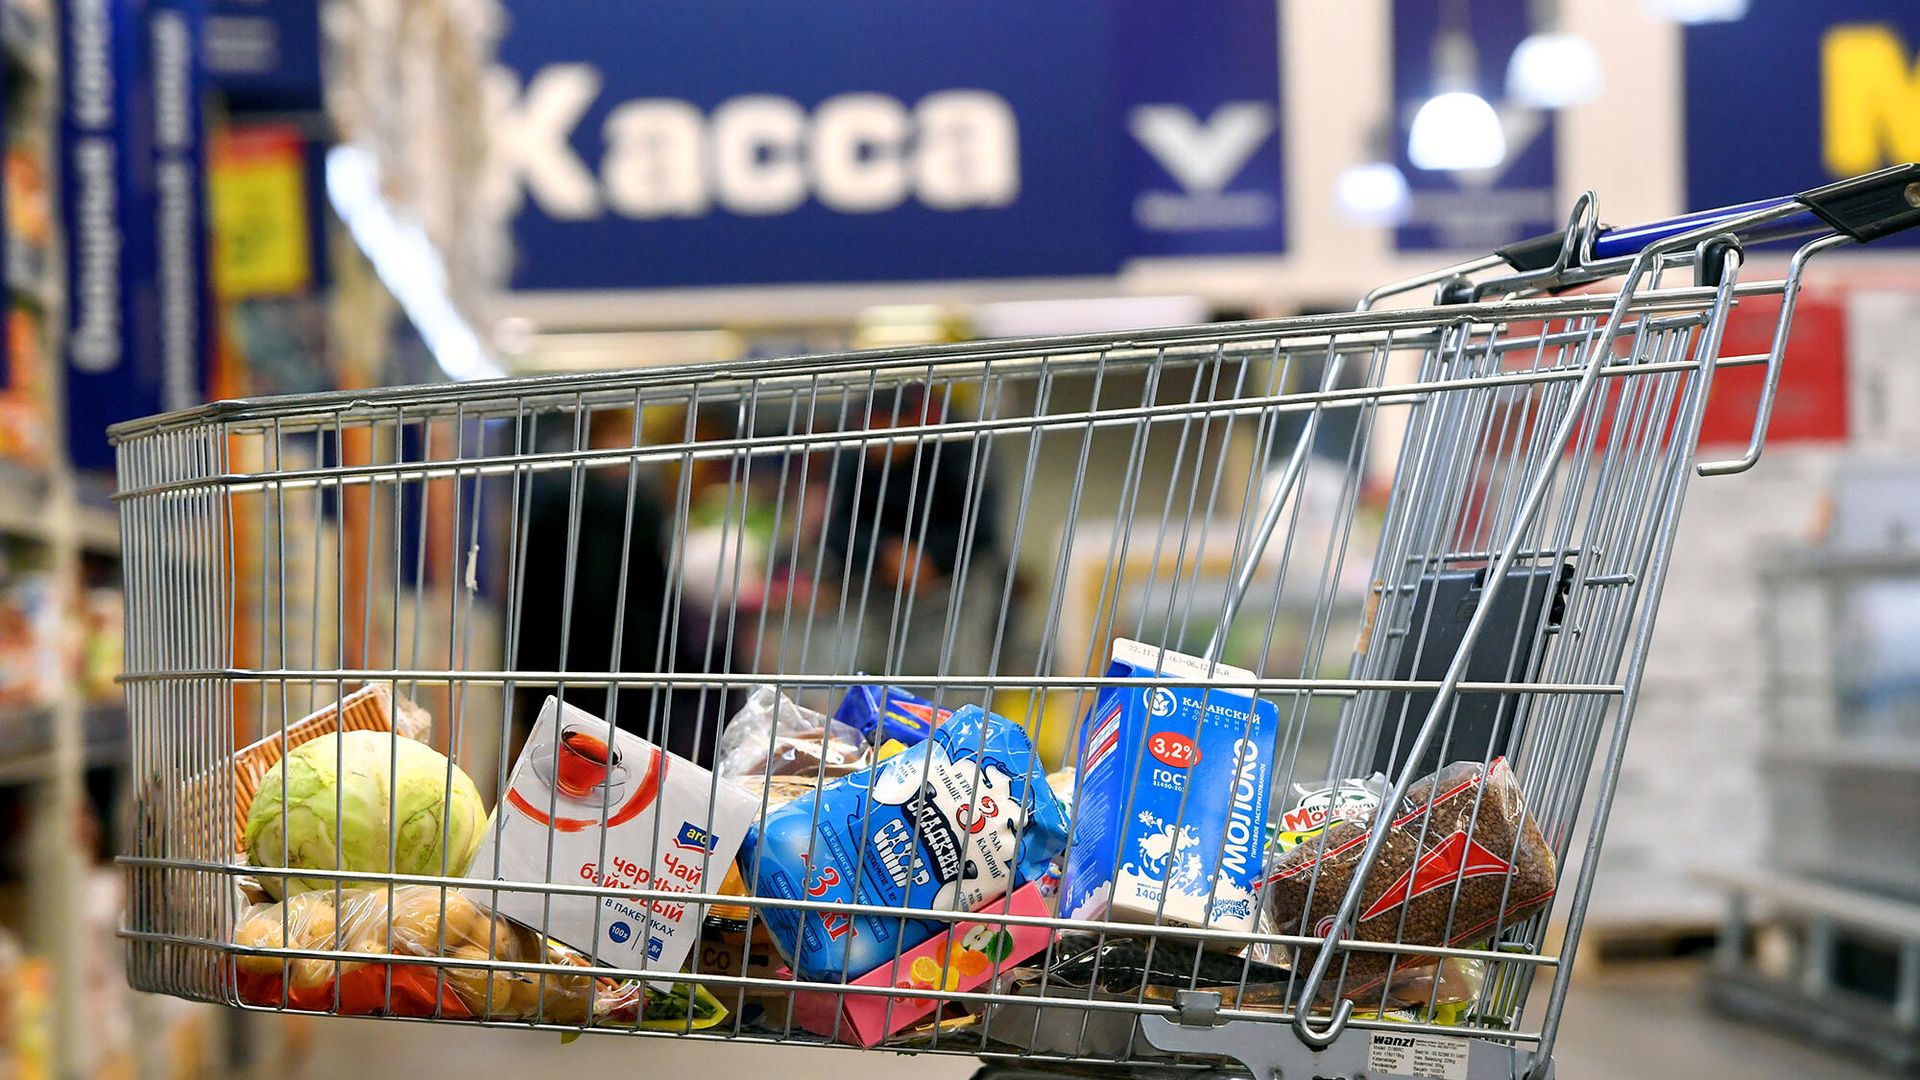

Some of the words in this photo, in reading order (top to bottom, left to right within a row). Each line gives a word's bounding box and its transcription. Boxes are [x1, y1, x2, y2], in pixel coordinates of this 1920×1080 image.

[492, 62, 1020, 220] Касса
[1182, 697, 1260, 724] КААНСКИЙ
[1153, 737, 1198, 762] 3,2%
[956, 796, 999, 834] 3
[1221, 737, 1259, 875] МОЛОКО
[873, 818, 930, 889] САХАР
[906, 798, 960, 880] СЛАДКИЙ
[989, 830, 1003, 853] РАЗА
[664, 853, 703, 885] Чай
[605, 898, 613, 907] В
[1374, 1035, 1415, 1048] wanzl
